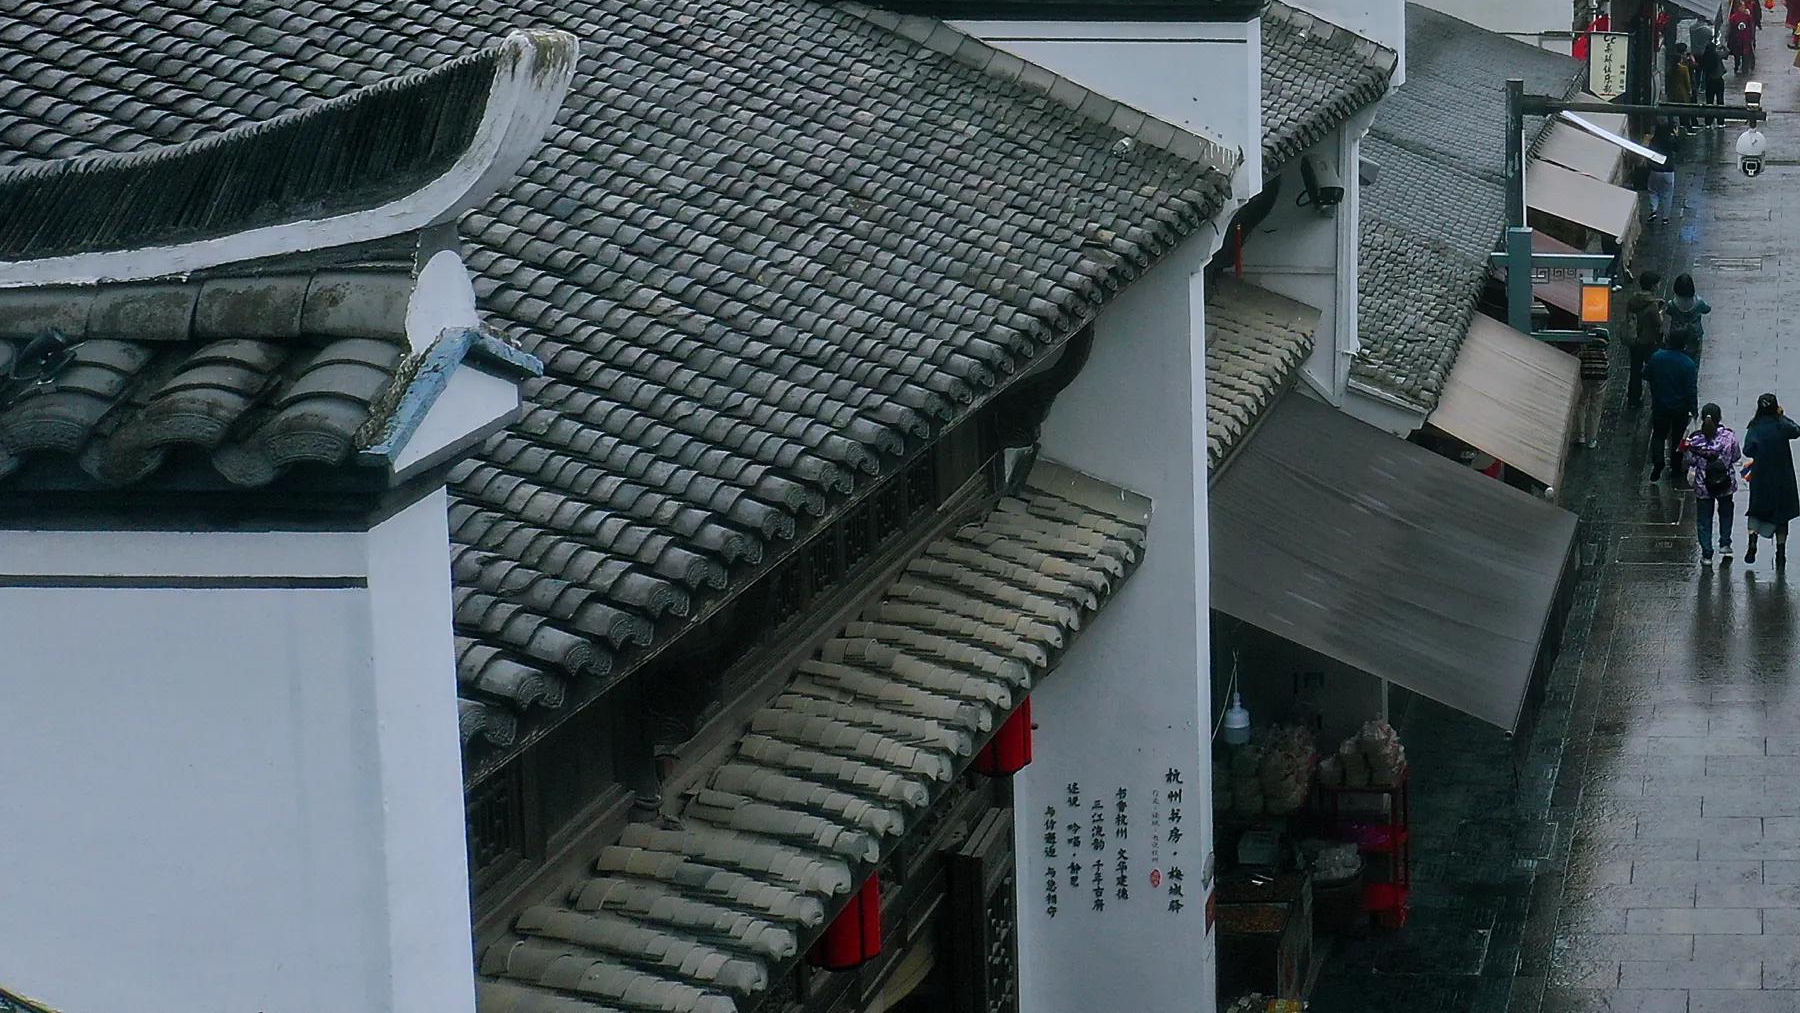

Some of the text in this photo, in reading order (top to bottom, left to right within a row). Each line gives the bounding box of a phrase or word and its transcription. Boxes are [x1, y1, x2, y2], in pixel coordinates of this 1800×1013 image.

[1090, 799, 1106, 851] 三江流韵
[1114, 786, 1129, 840] 书香杭州
